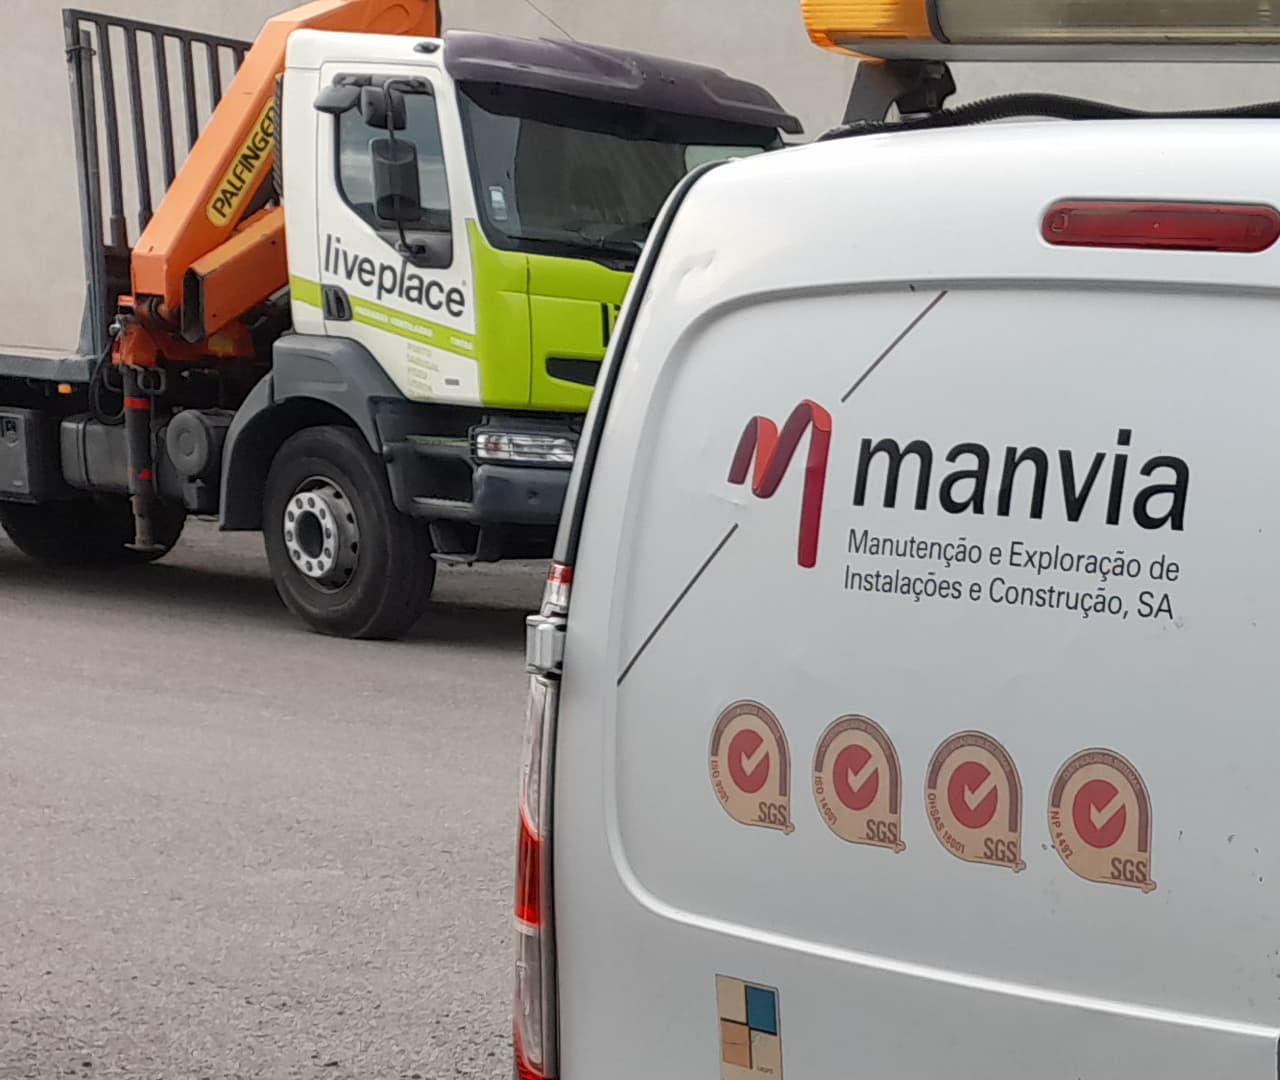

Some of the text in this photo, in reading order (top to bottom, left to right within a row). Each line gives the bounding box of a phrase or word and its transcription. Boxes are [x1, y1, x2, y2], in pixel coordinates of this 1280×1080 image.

[324, 233, 466, 318] liveplace
[851, 428, 1191, 532] manvia
[847, 528, 1181, 583] Manutenção e Exploração de
[843, 564, 1175, 620] Instalações e Construção, SA
[758, 801, 788, 826] SGS
[865, 818, 898, 844] SGS
[983, 837, 1018, 863] SGS
[1110, 857, 1148, 884] SGS
